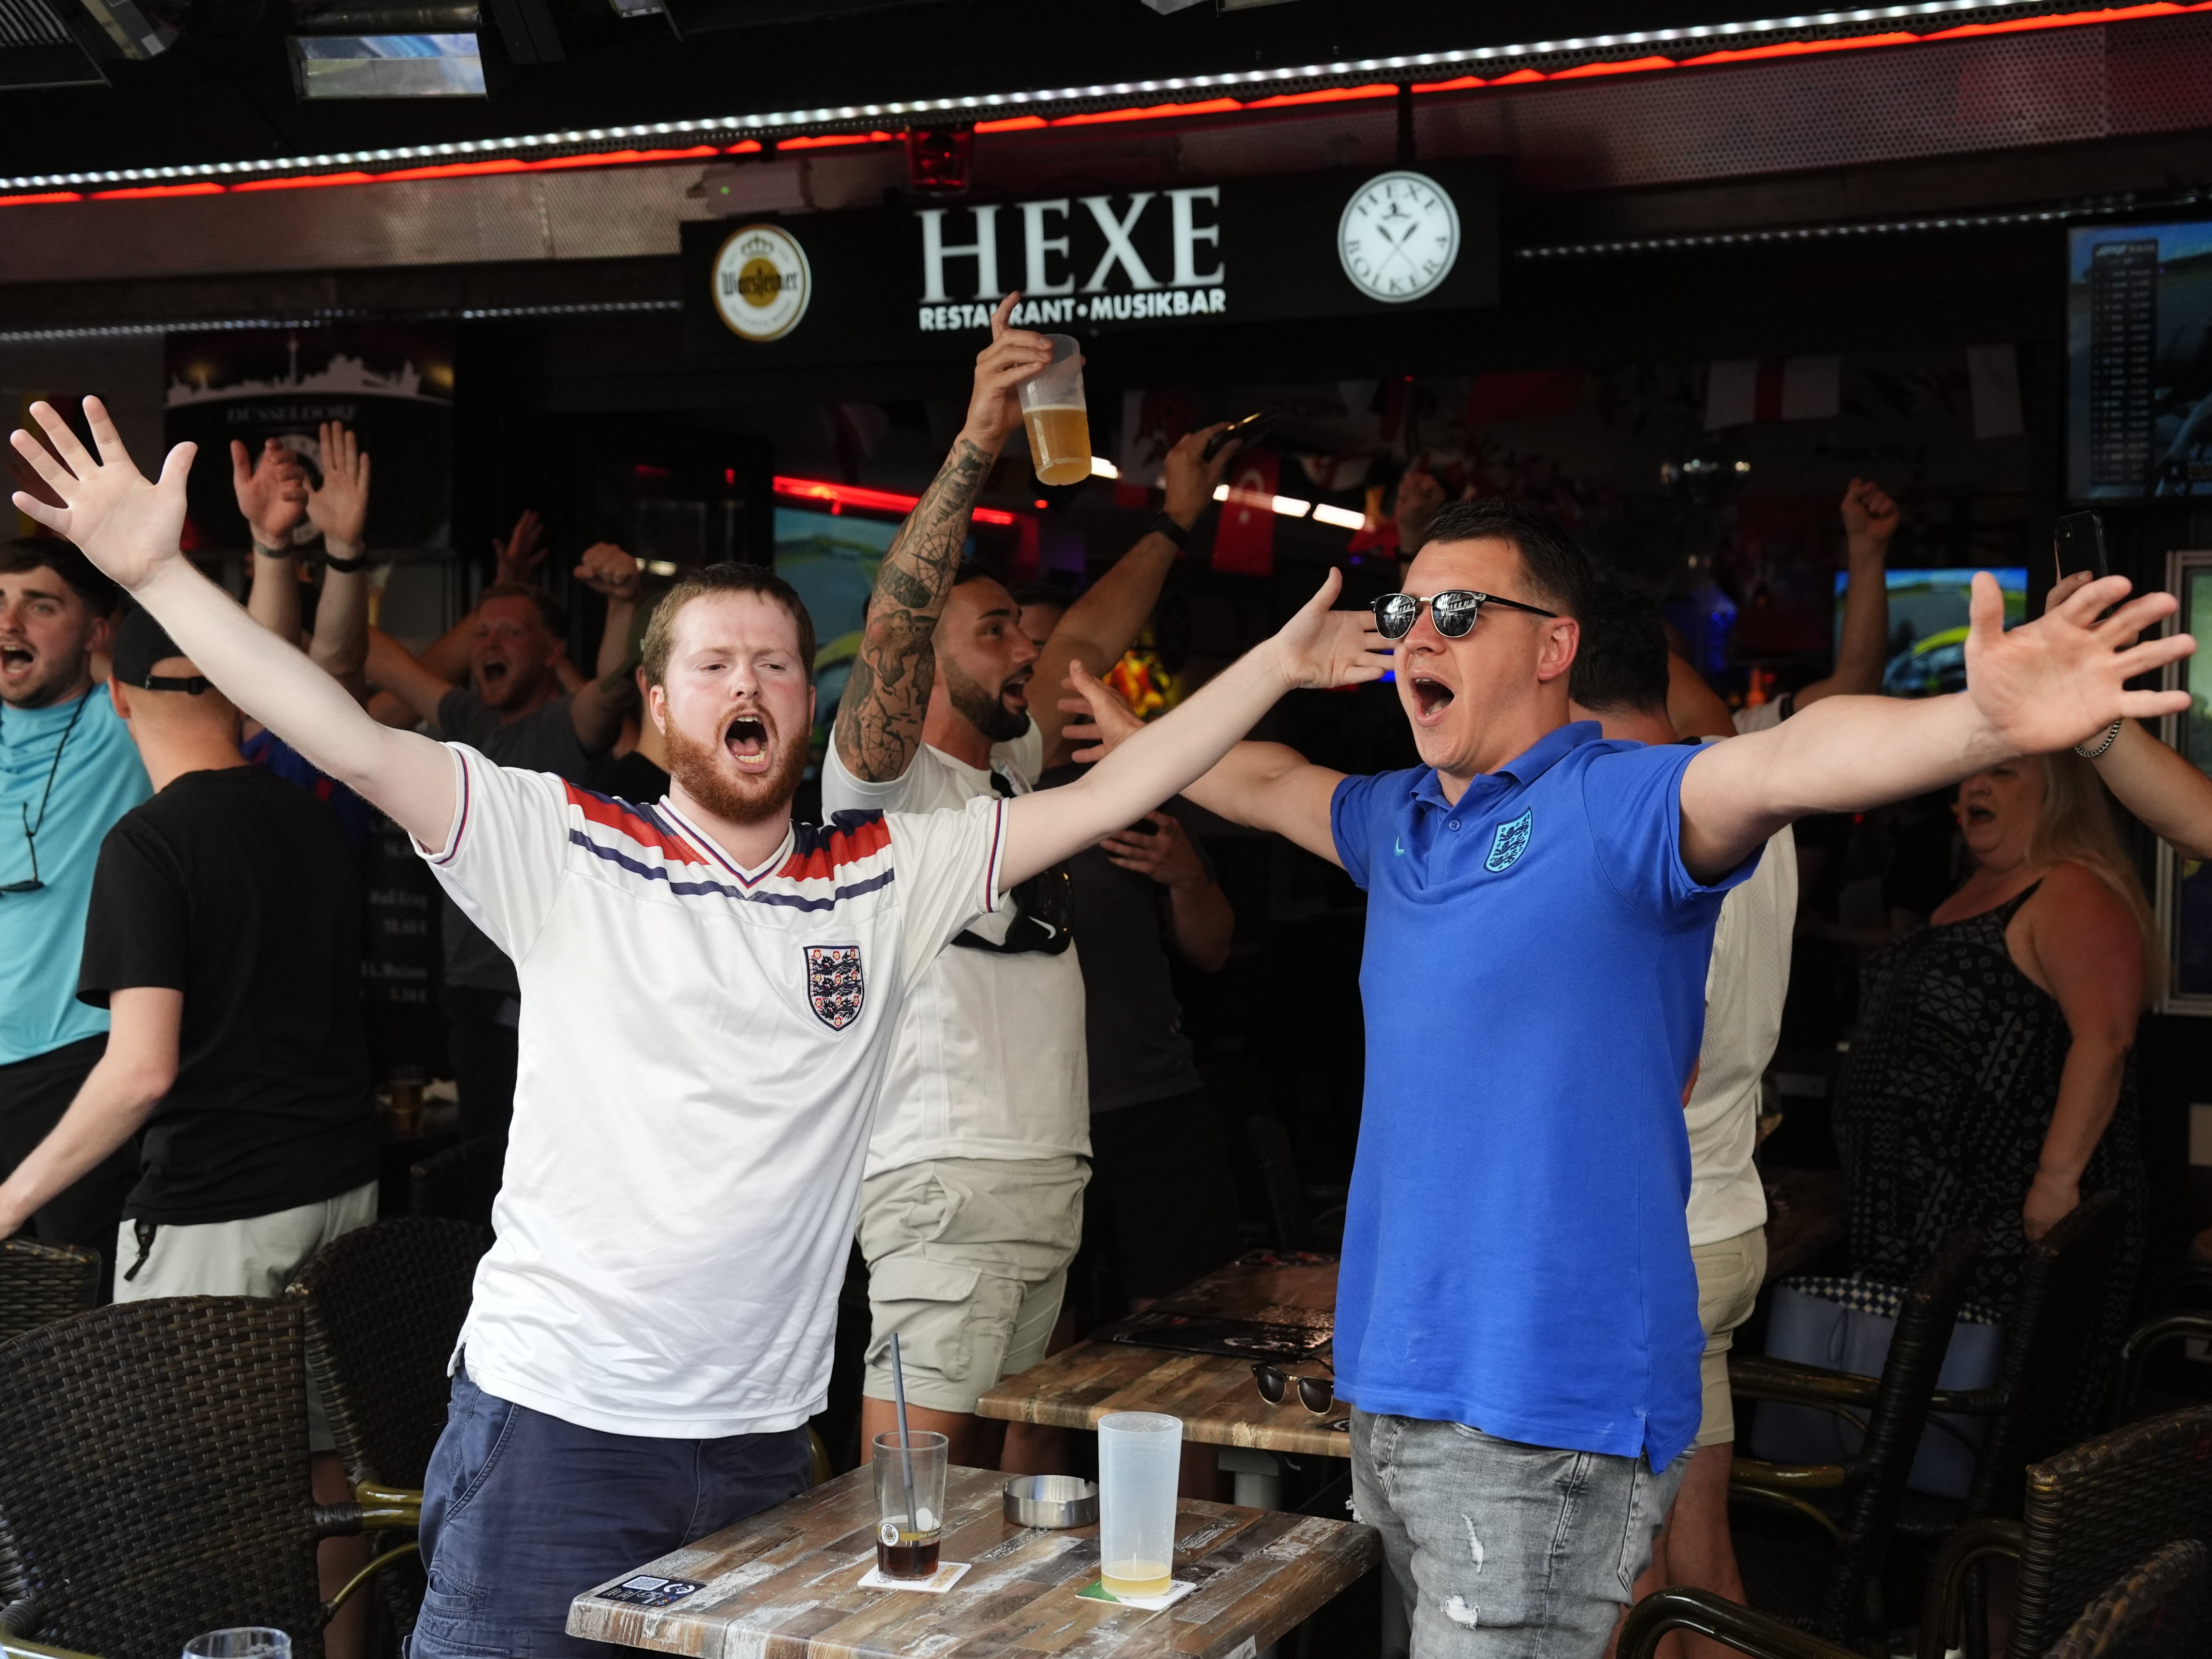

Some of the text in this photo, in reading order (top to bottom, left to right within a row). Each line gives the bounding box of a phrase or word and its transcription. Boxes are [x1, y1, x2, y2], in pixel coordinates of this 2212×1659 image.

[915, 186, 1225, 303] HEXE
[918, 288, 1227, 331] RESTARANT MUSIKBAR
